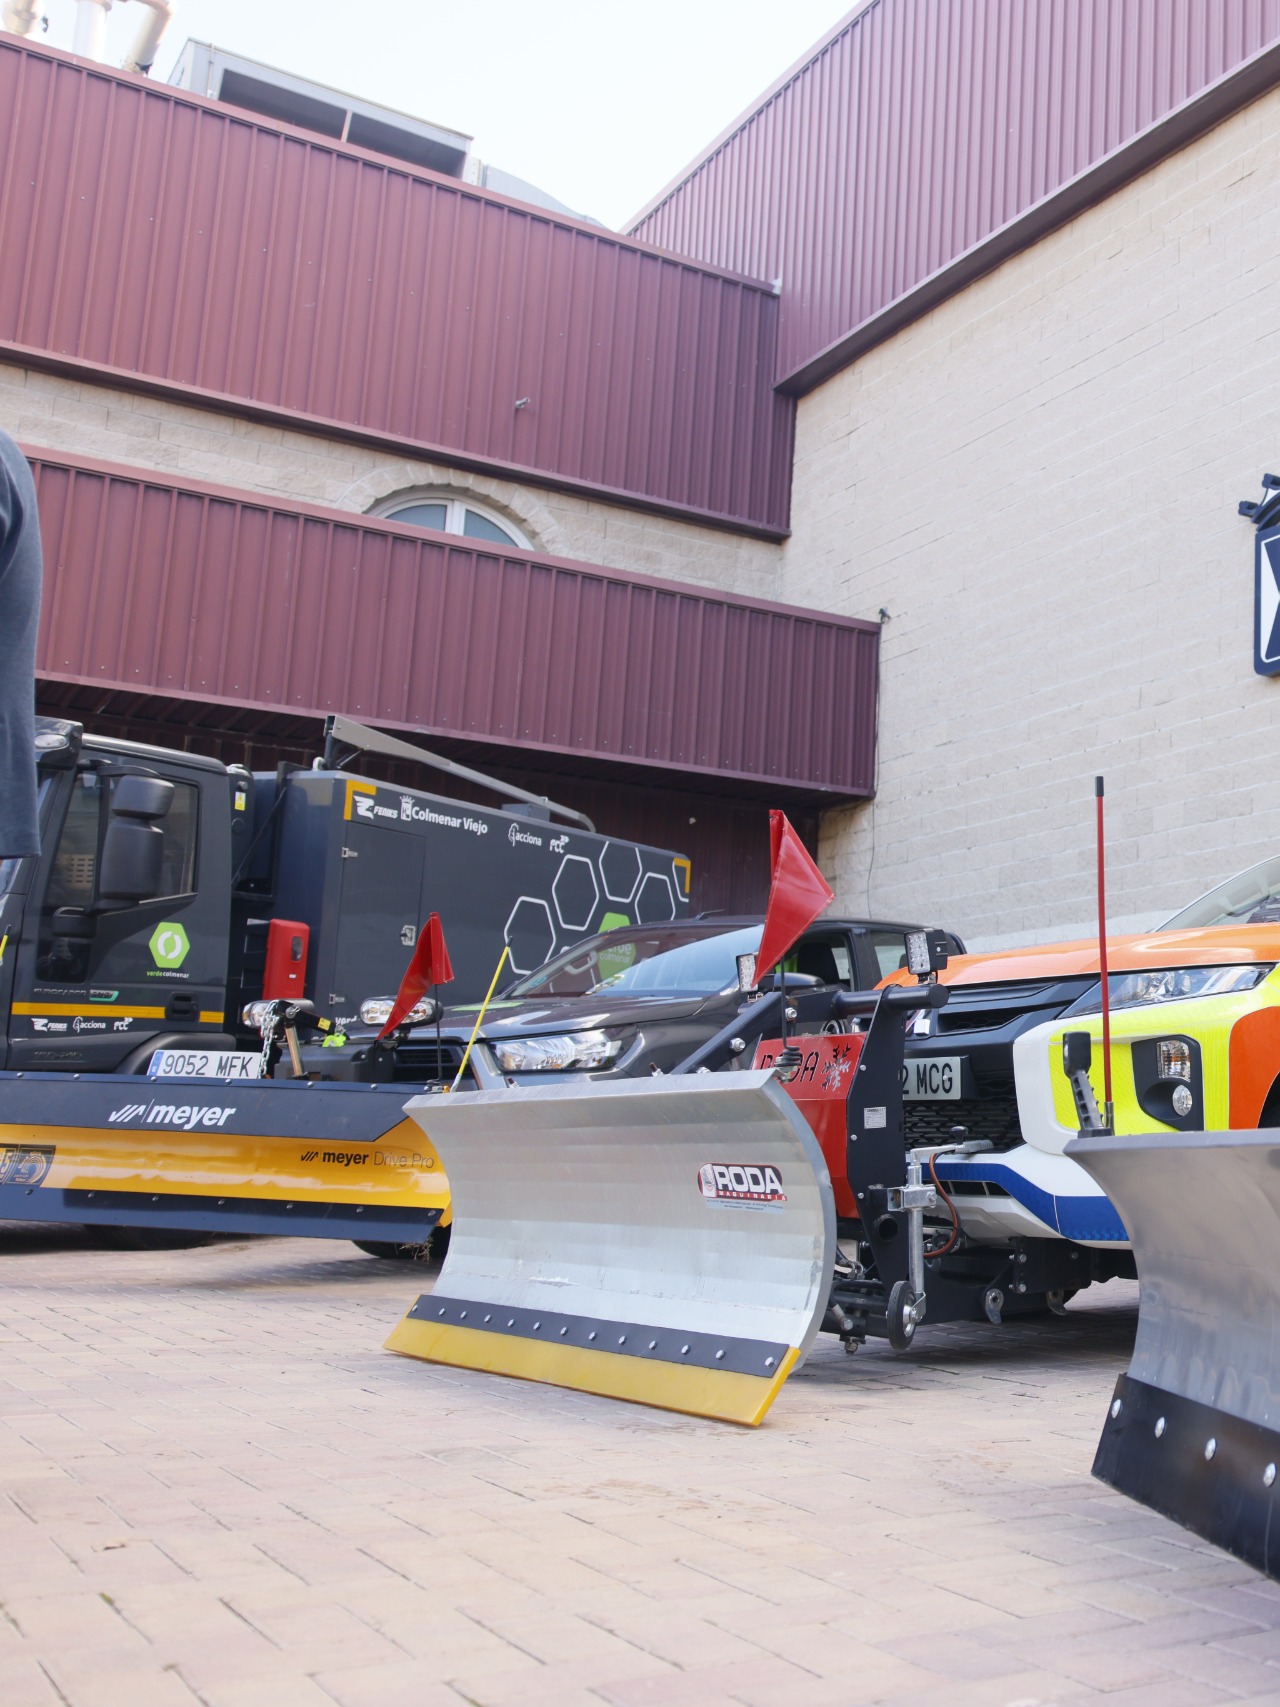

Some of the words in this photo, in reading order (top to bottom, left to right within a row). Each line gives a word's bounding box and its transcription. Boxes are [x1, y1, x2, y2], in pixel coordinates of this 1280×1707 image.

[411, 806, 462, 828] Colmenar
[463, 817, 488, 835] Viejo
[515, 831, 542, 846] acciona
[80, 1020, 106, 1029] acciona
[162, 1054, 209, 1076] 9052
[215, 1055, 253, 1077] MFK
[916, 1062, 953, 1095] MCG
[146, 1105, 237, 1130] meyer
[322, 1151, 369, 1167] meyer
[373, 1151, 408, 1167] Drive
[411, 1152, 435, 1169] Pro
[712, 1165, 784, 1194] RODA
[719, 1190, 787, 1201] MAQUINARIA
